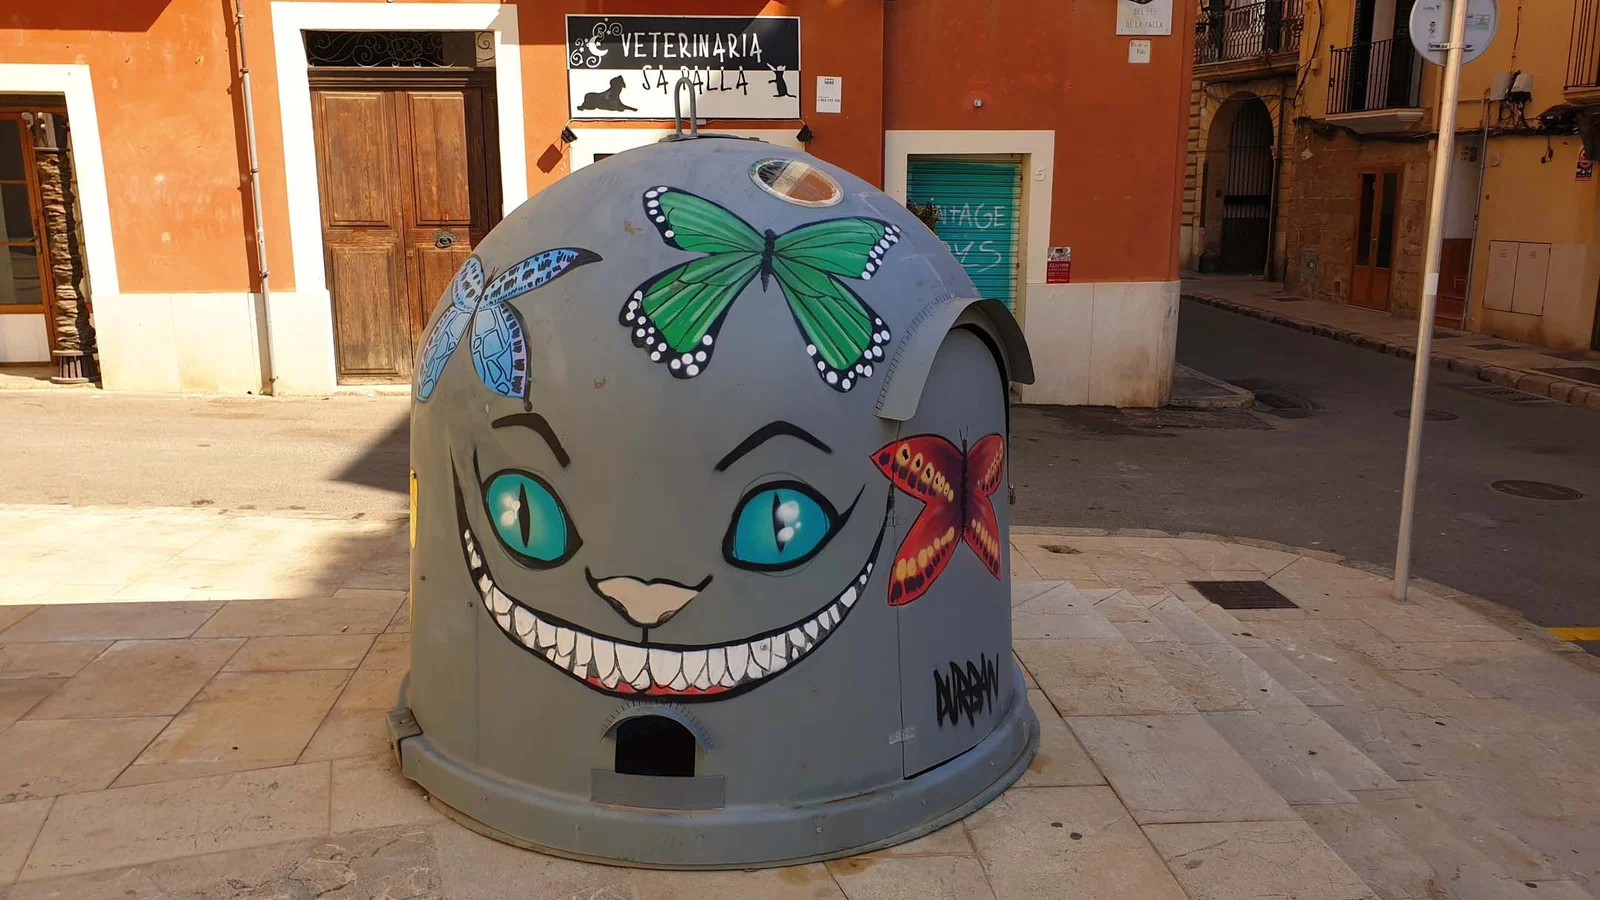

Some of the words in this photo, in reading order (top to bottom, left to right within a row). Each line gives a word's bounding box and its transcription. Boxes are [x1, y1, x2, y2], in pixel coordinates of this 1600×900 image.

[1125, 20, 1133, 28] DE
[1135, 20, 1143, 28] LA
[621, 32, 763, 63] VETERINARIA
[642, 64, 668, 95] SA
[680, 65, 749, 96] PALLA
[1034, 169, 1046, 182] 5
[932, 203, 1006, 229] NTAGE
[943, 240, 1002, 273] YS
